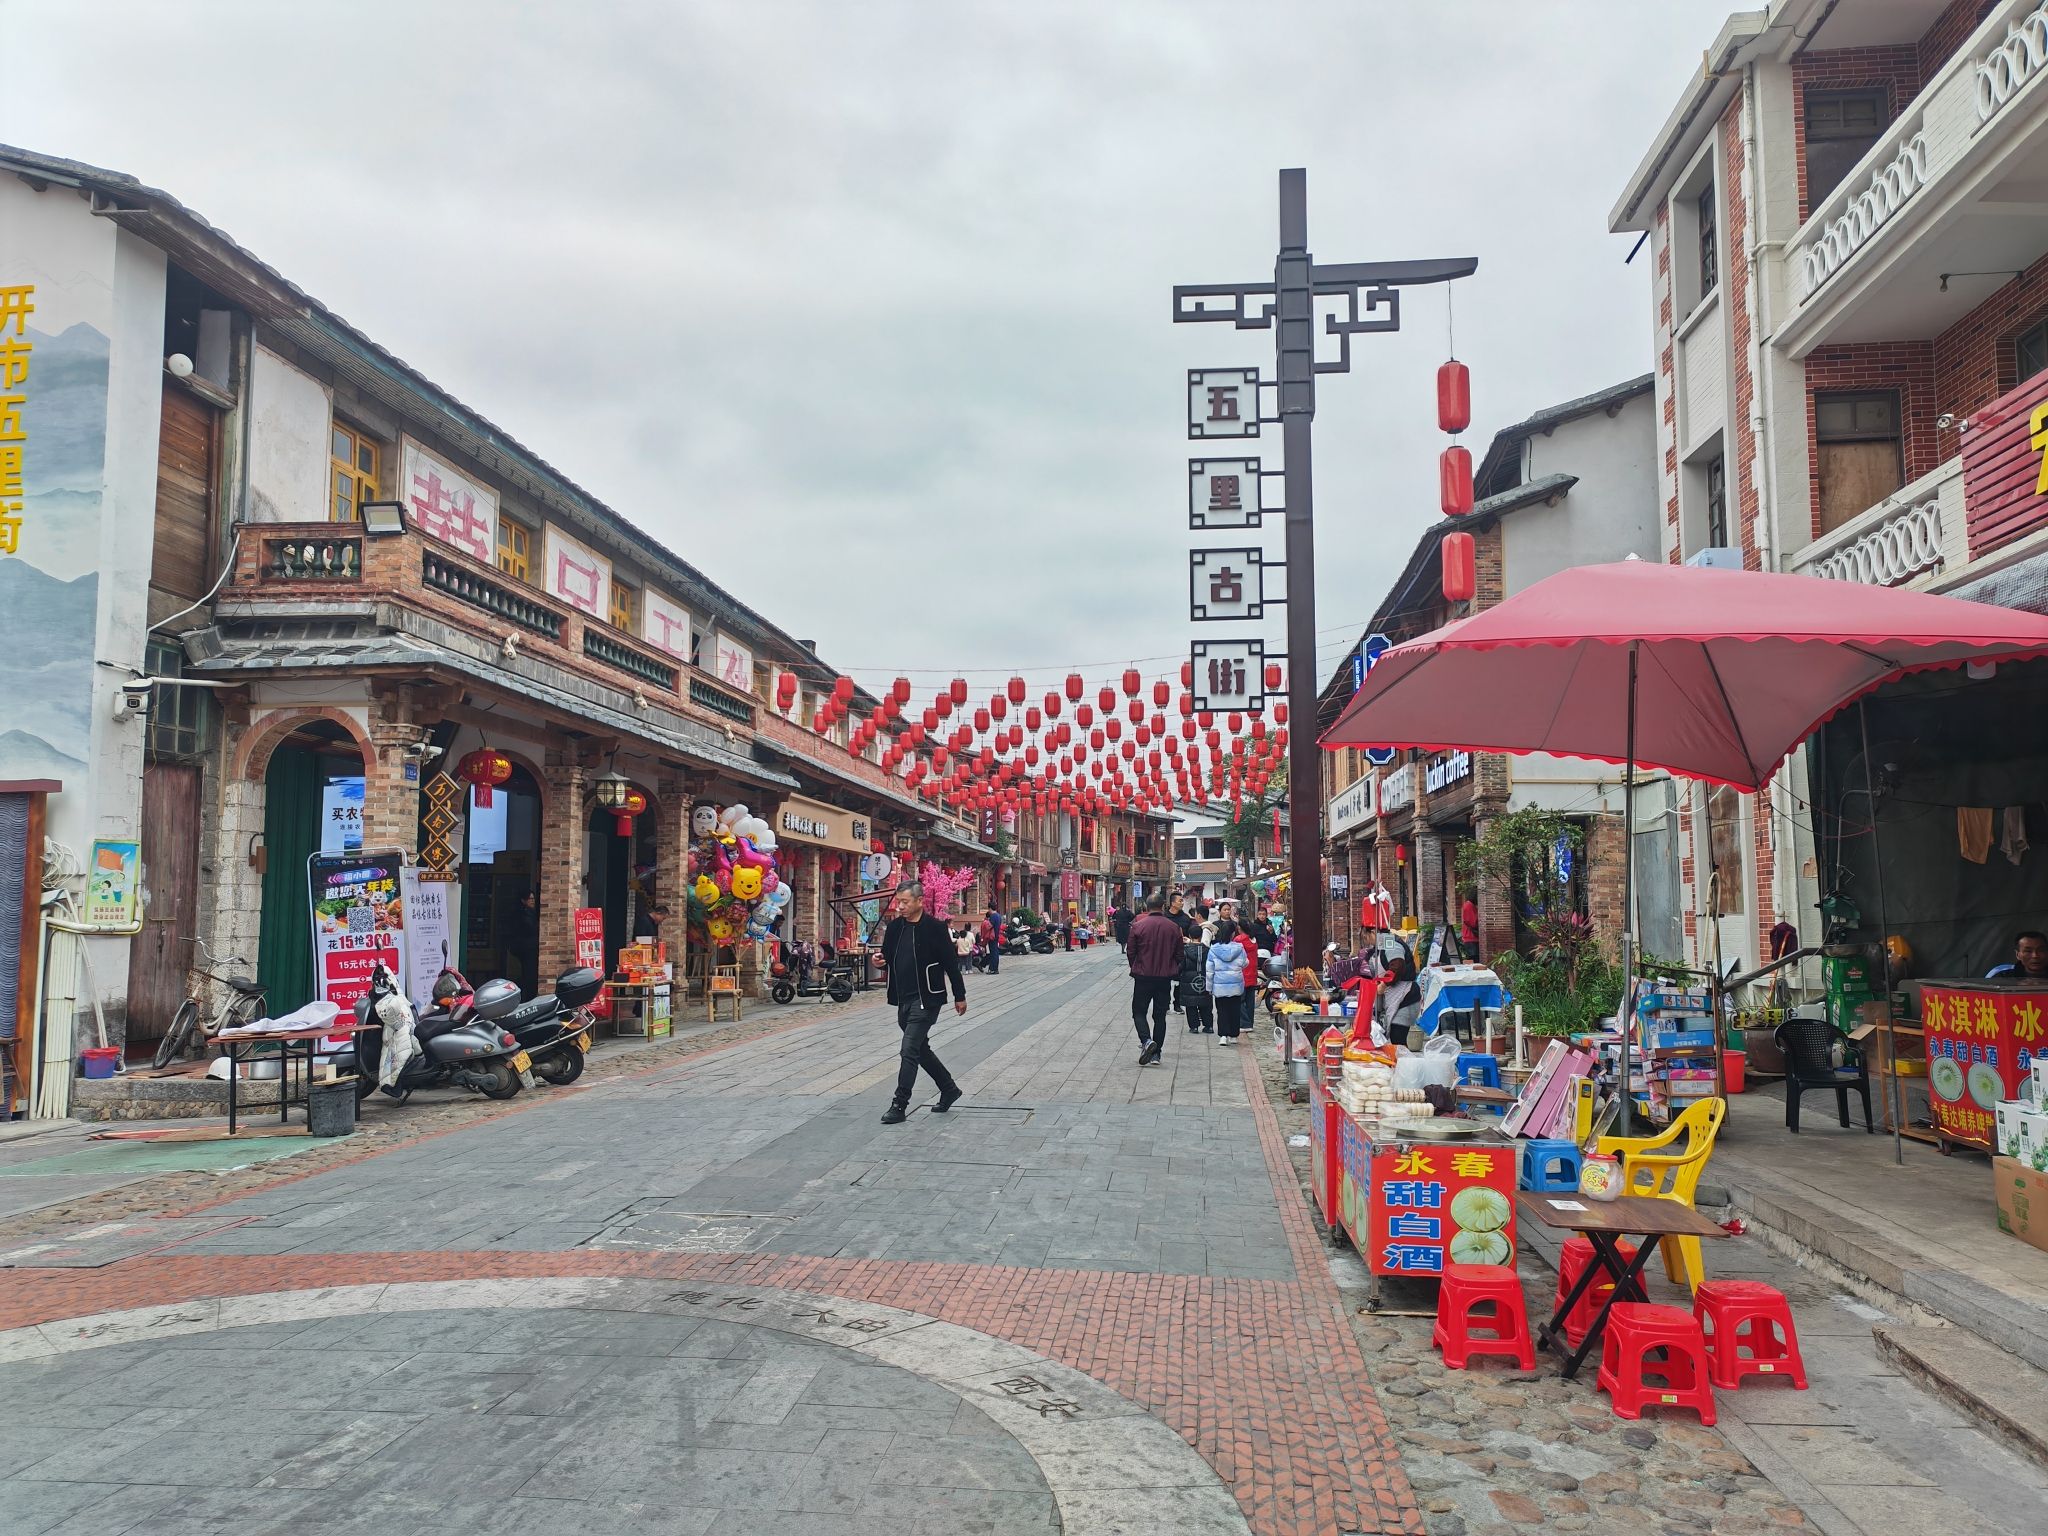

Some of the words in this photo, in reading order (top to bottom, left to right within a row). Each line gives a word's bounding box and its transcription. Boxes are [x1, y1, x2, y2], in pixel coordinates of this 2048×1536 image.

[1207, 385, 1246, 695] 五里古街
[1425, 756, 1445, 795] luckin
[1445, 748, 1470, 785] coffee
[1925, 994, 2000, 1039] 冰淇淋
[1929, 1036, 1999, 1069] 永春甜白酒
[1393, 1151, 1496, 1178] 永春
[1382, 1180, 1447, 1272] 甜白酒
